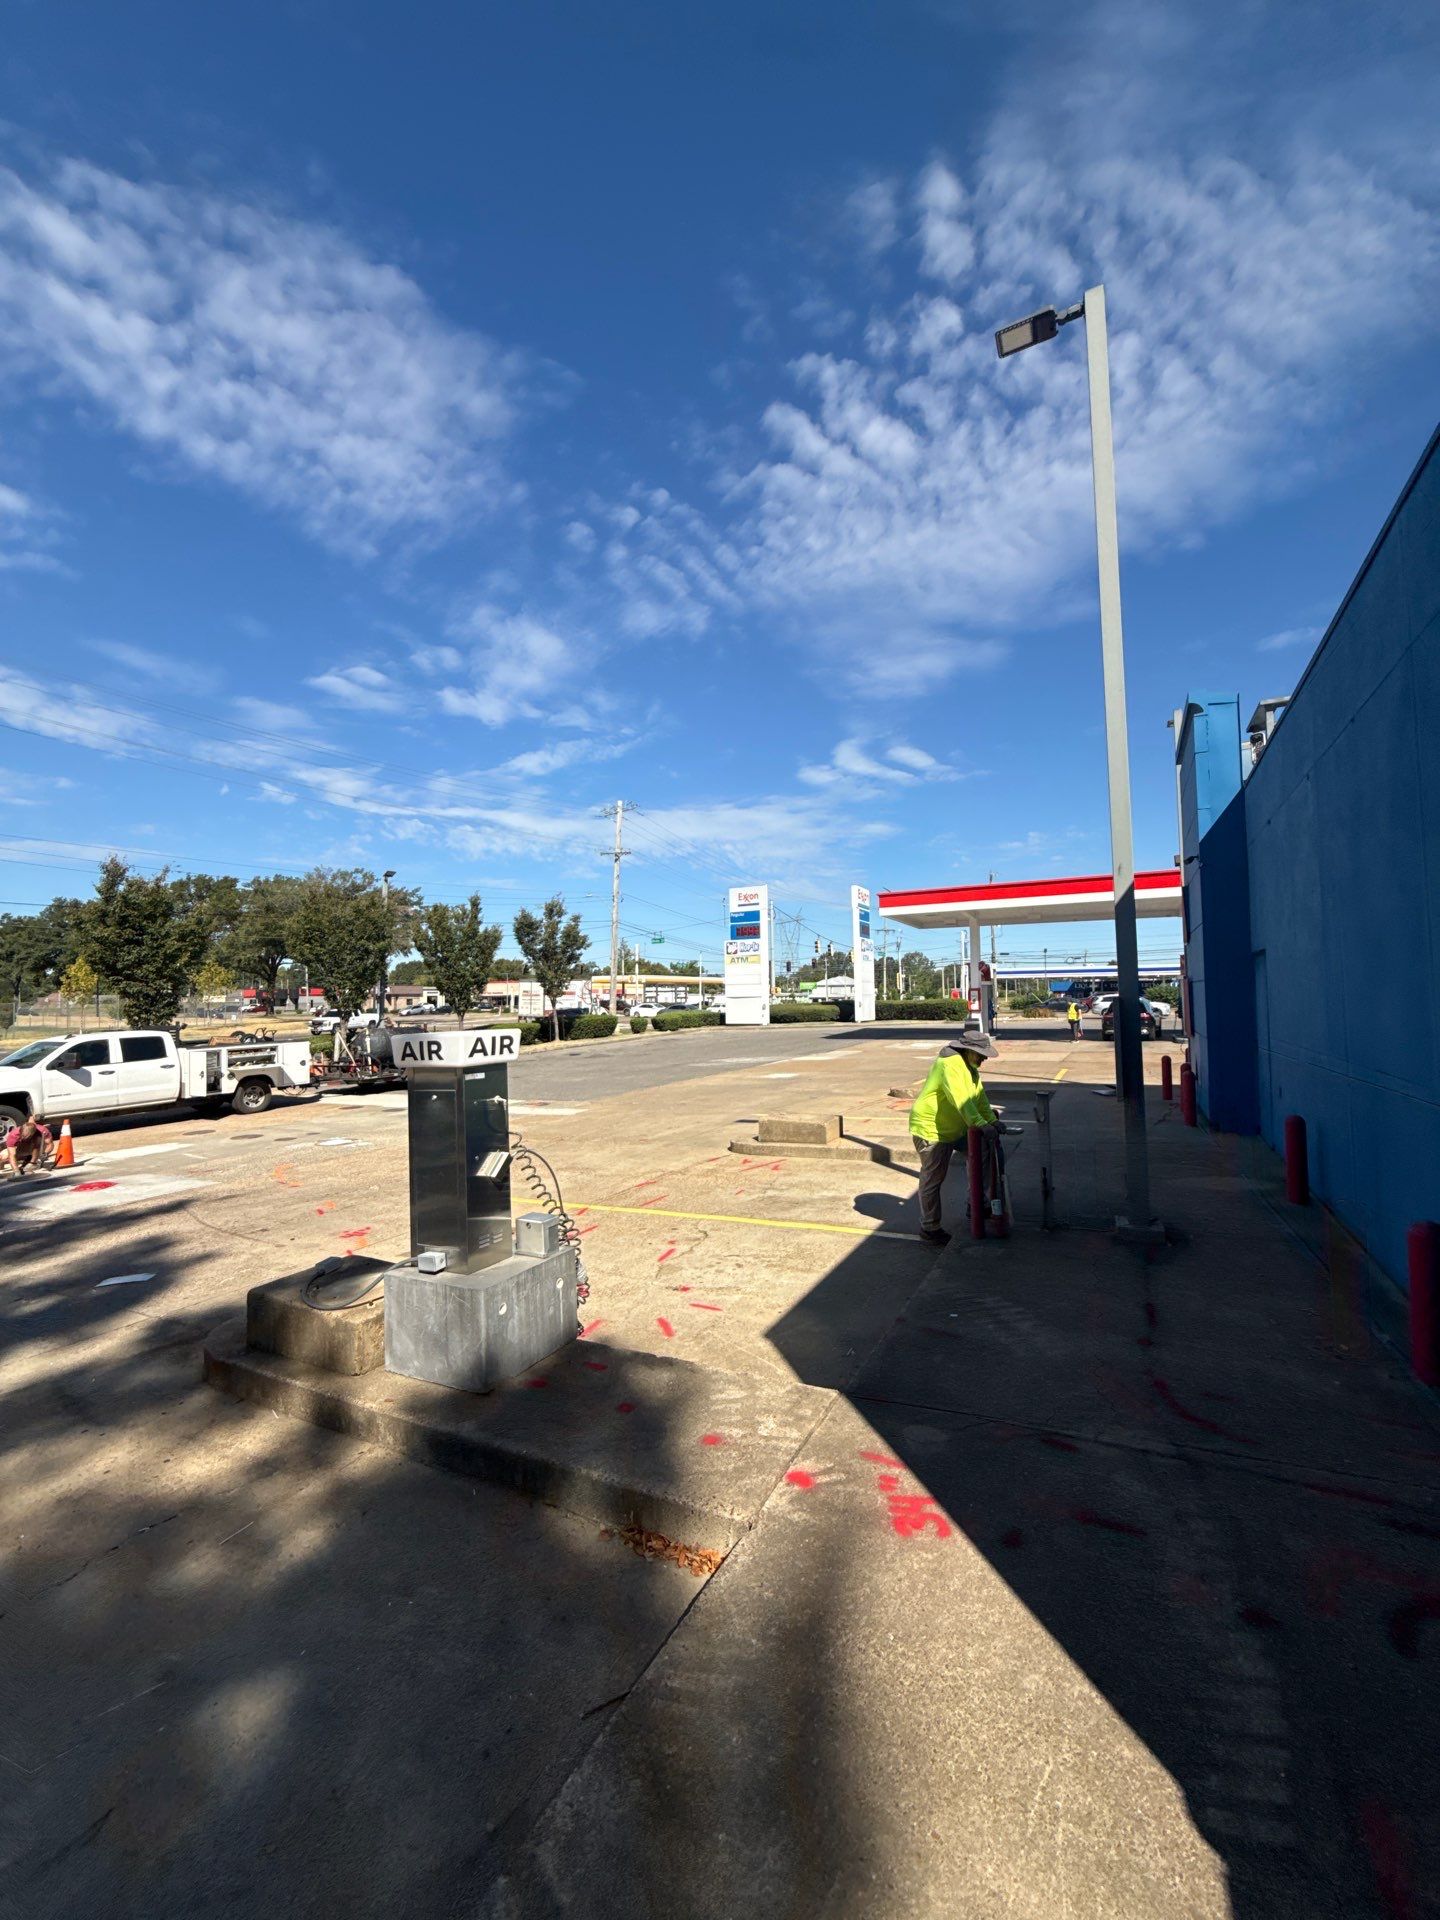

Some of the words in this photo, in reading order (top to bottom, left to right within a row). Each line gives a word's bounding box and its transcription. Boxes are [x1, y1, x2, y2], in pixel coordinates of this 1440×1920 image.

[738, 893, 759, 903] Exxon
[730, 956, 749, 965] ATM
[401, 1040, 444, 1061] AIR
[468, 1035, 514, 1058] AIR
